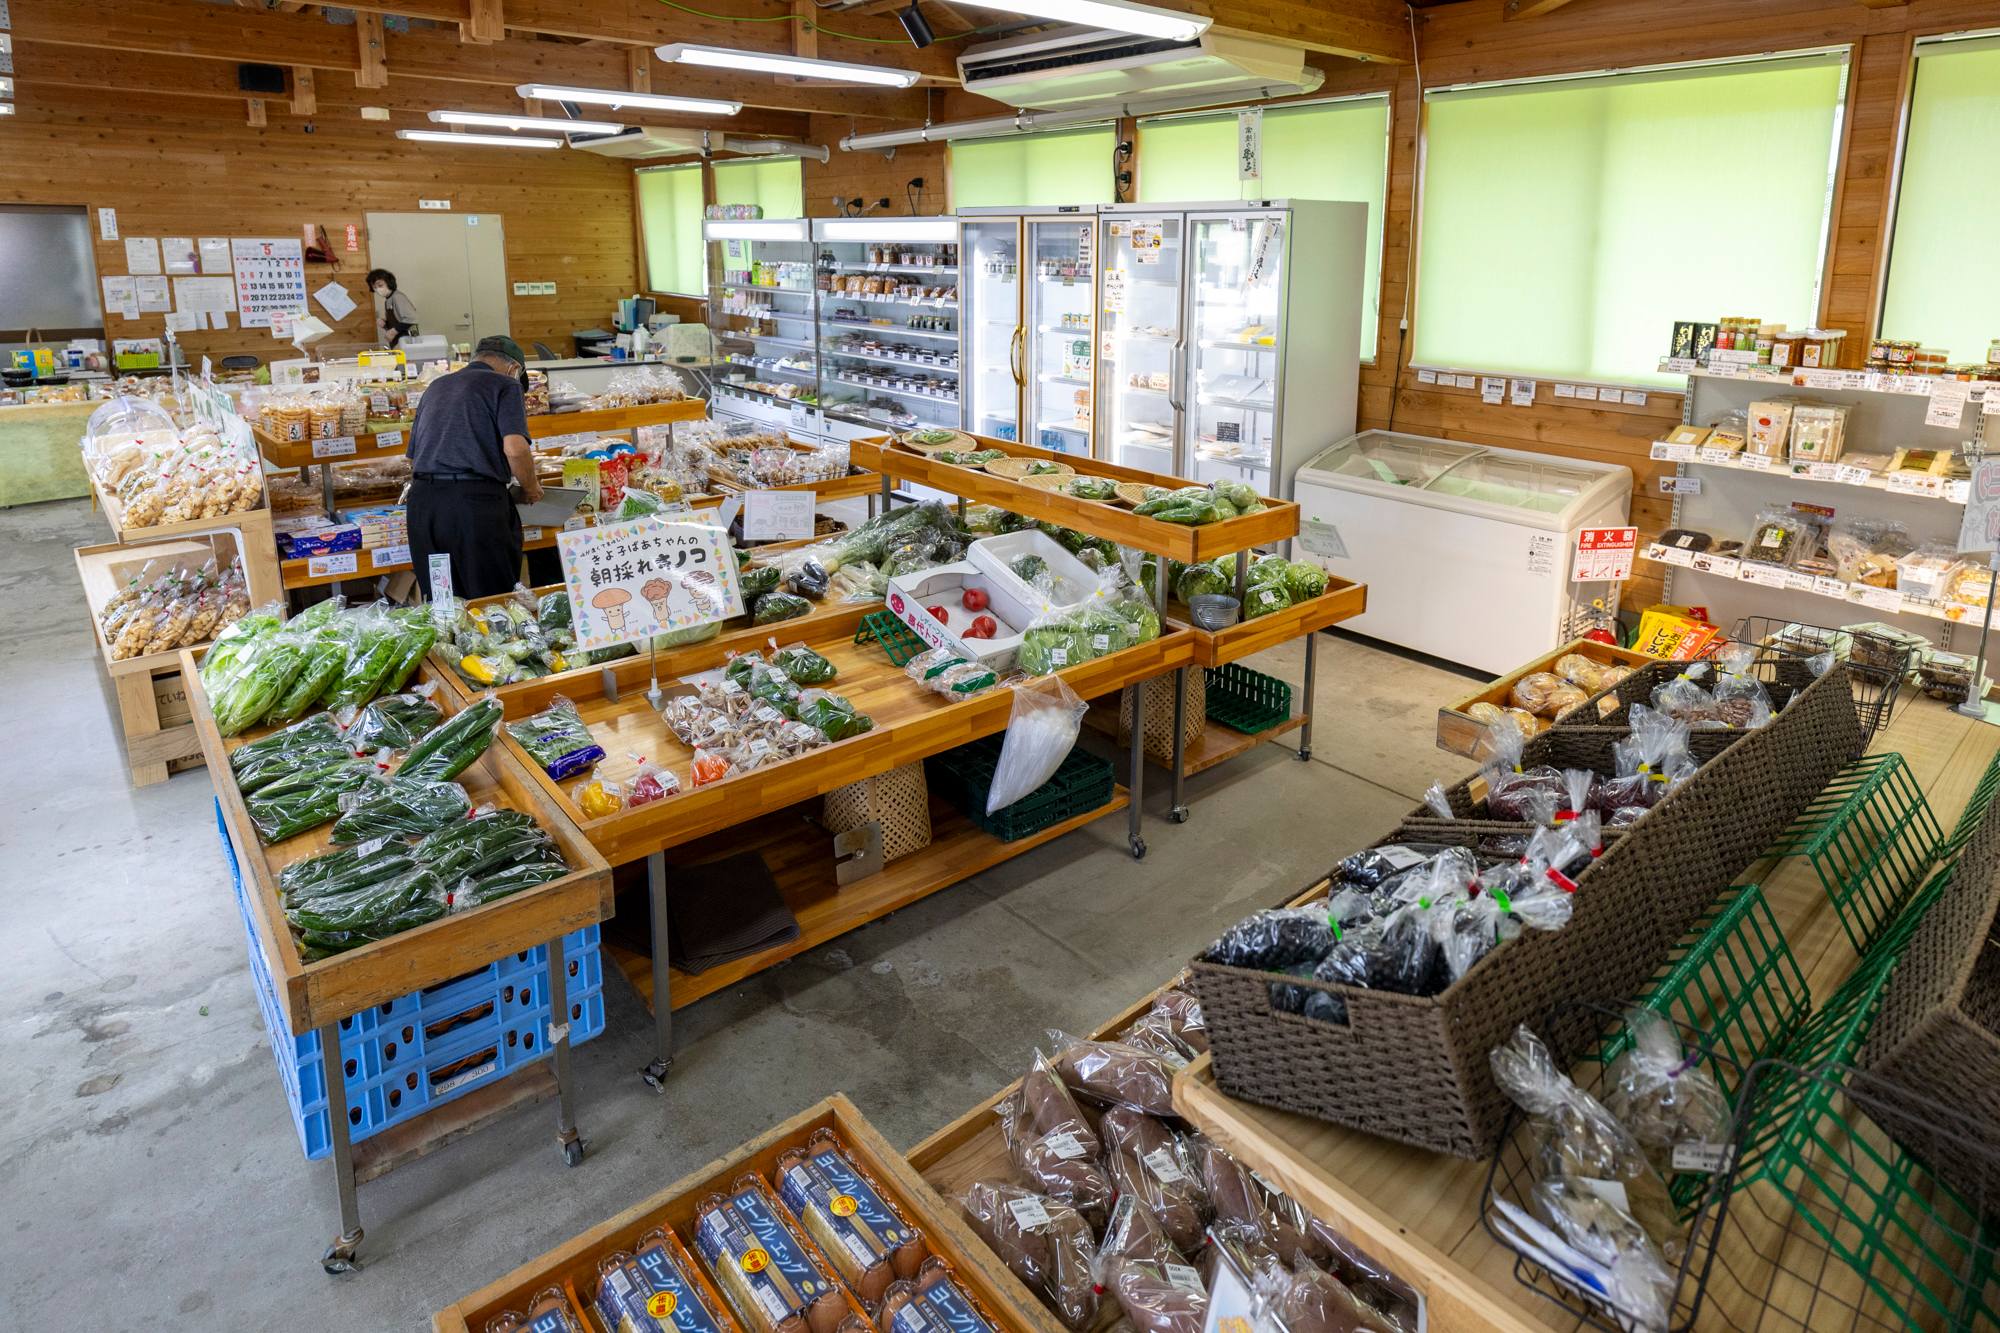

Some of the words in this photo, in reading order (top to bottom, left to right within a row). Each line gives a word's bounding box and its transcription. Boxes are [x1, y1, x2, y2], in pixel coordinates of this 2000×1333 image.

[263, 246, 271, 256] 5
[1583, 530, 1634, 542] 消火器
[592, 536, 698, 566] きよ子ばあちゃんの
[591, 548, 706, 587] 朝採れキノコ
[1646, 628, 1669, 655] しじみ
[736, 1194, 809, 1274] ヨーグルエッグ
